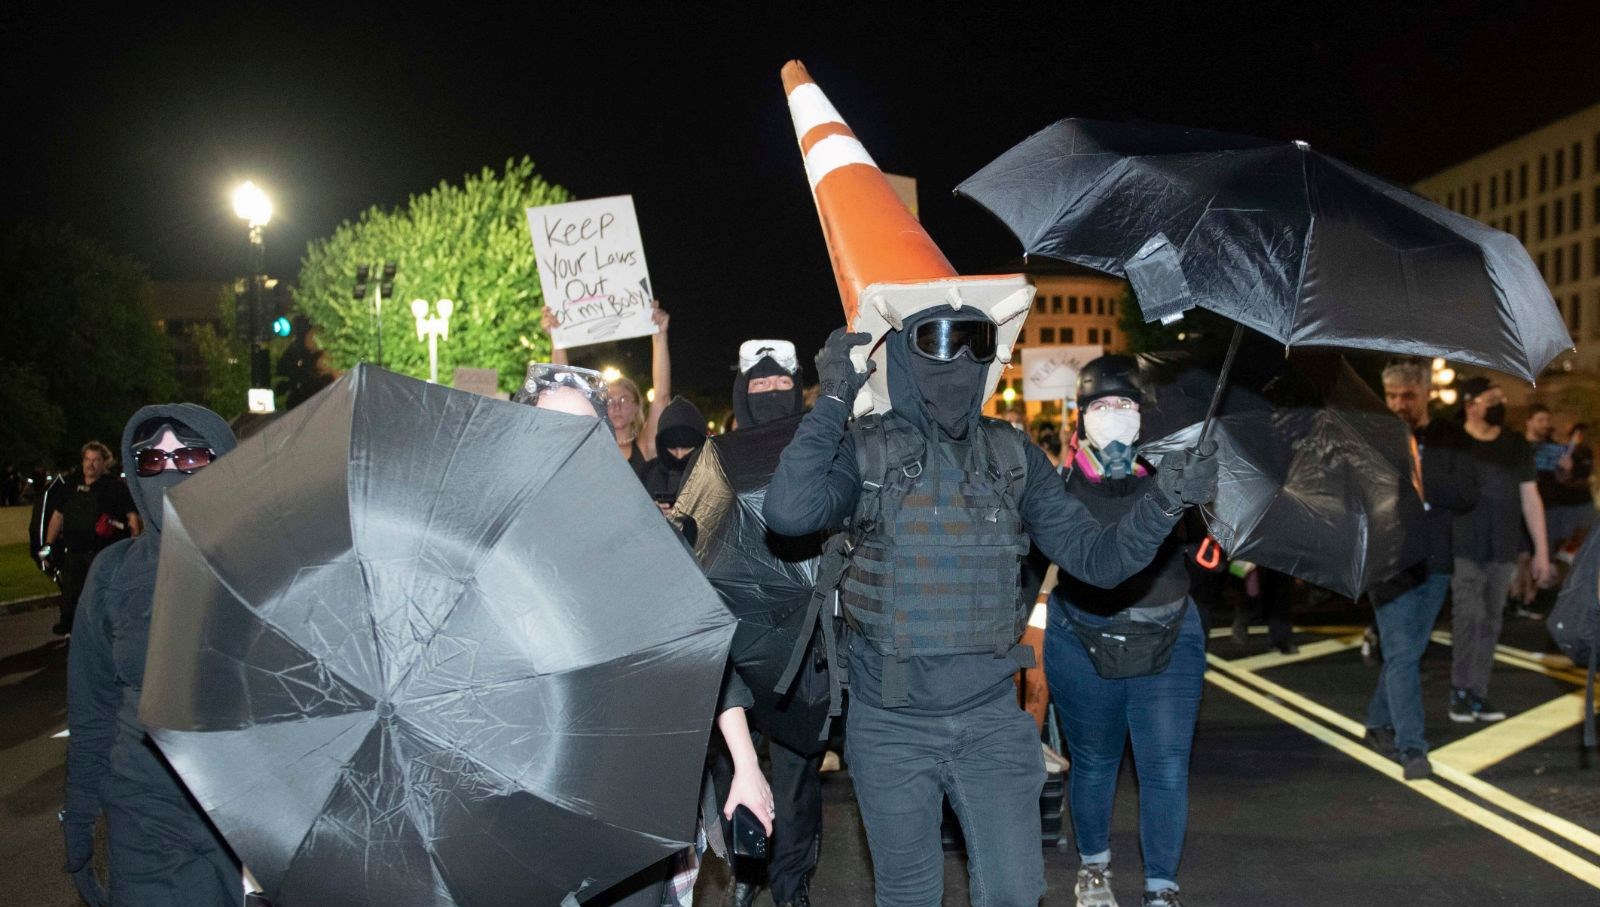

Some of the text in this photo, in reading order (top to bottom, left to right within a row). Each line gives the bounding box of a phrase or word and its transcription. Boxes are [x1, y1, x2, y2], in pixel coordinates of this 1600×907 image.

[544, 213, 614, 248] Keep
[543, 246, 637, 289] Your Laws
[565, 277, 608, 303] Out
[555, 300, 573, 325] of
[579, 302, 605, 318] my
